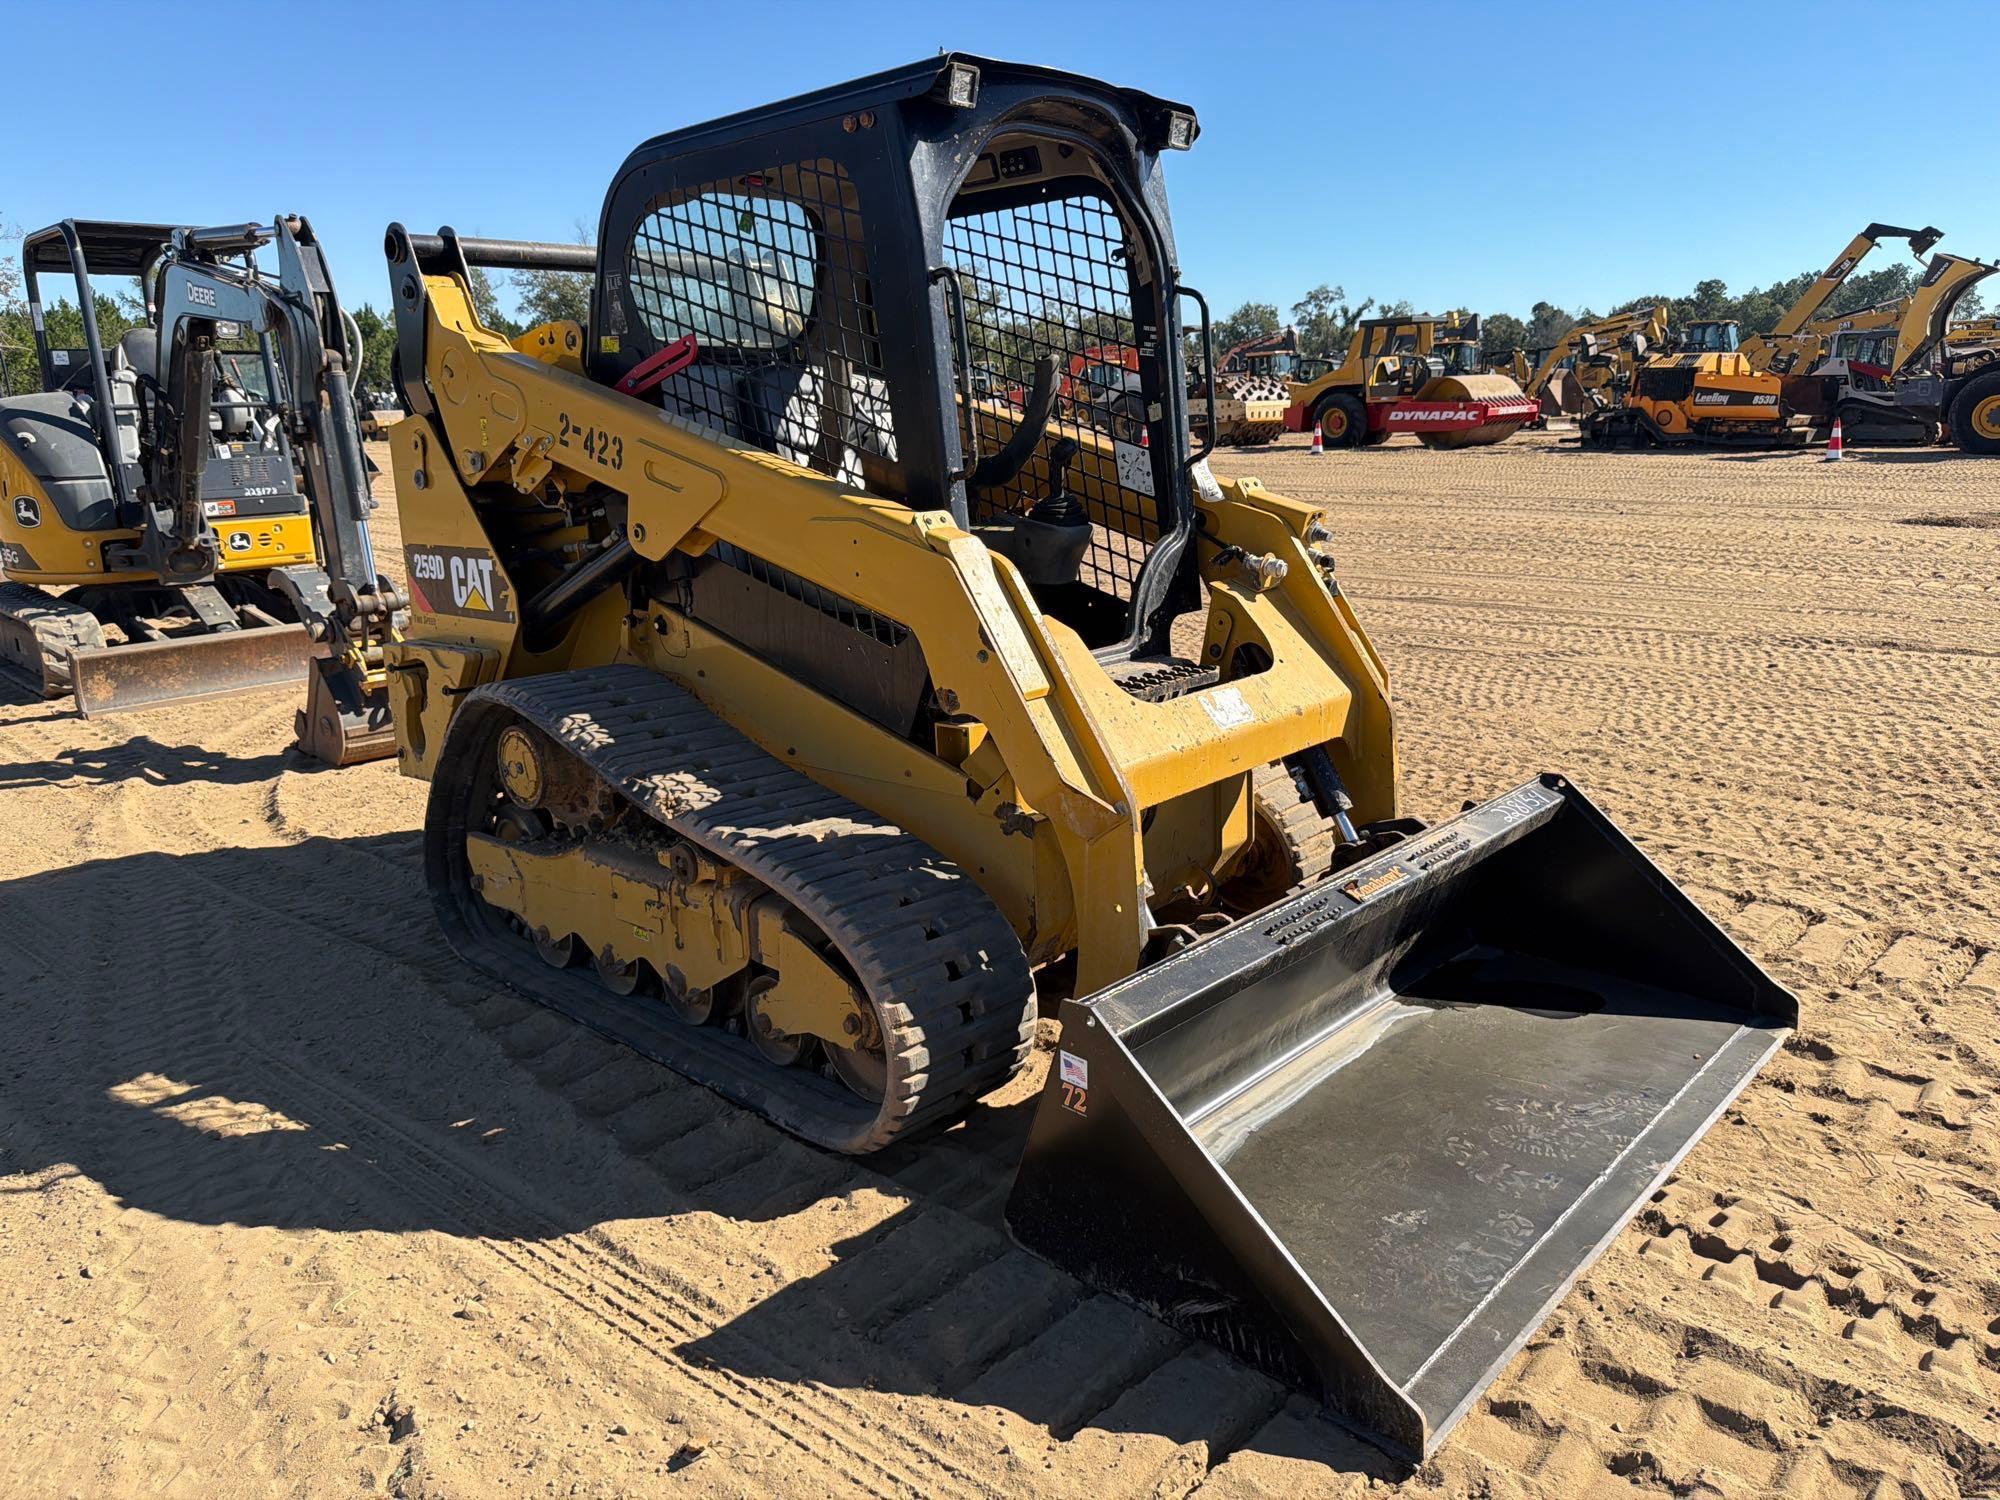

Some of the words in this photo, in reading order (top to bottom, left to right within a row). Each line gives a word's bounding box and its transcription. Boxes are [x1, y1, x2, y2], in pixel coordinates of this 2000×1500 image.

[1929, 262, 1950, 283] VOLVO
[187, 281, 216, 307] DEERE
[1838, 322, 1851, 330] CAT
[1695, 392, 1730, 405] LeeBoy
[1752, 395, 1776, 405] 8530
[1389, 411, 1480, 421] DYNAPAC
[559, 412, 624, 470] 2-423
[413, 553, 445, 580] 259D
[450, 556, 494, 612] CAT
[1062, 1082, 1087, 1113] 72
